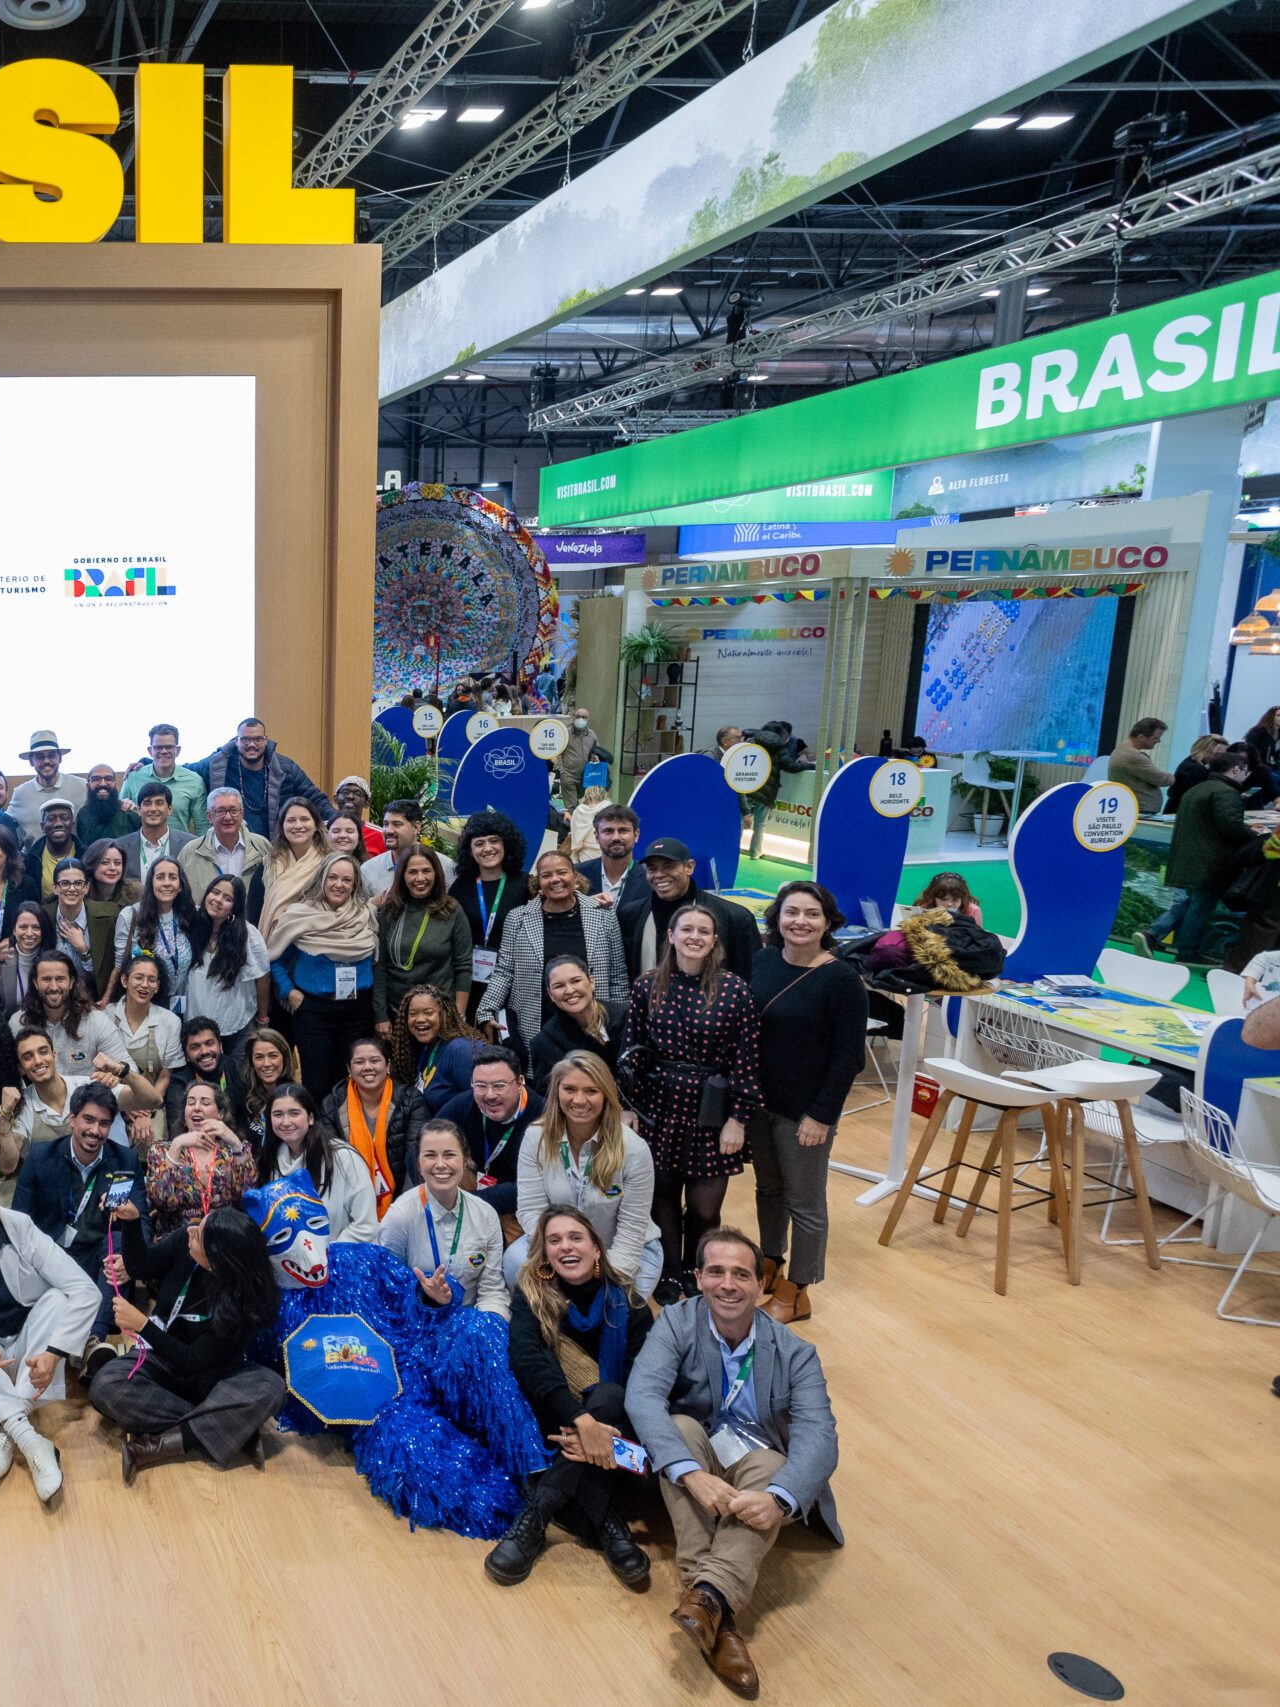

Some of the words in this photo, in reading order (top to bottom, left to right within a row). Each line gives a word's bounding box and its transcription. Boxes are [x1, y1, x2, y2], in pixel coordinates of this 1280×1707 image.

[974, 291, 1280, 431] BRASIL
[556, 474, 617, 500] VISITBRASIL.COM
[948, 479, 967, 491] ALTA
[969, 472, 1010, 488] FLORESTA
[785, 483, 874, 498] VISITBRASIL.COM
[925, 545, 1169, 572] PERNAMBUCO
[660, 553, 822, 588] PERNAMBUCO
[63, 566, 177, 598] BRASIL
[0, 586, 46, 594] TURISMO
[702, 626, 826, 641] PERNAMBUCO
[423, 712, 434, 721] 15
[478, 719, 489, 729] 16
[543, 728, 555, 739] 16
[742, 754, 757, 767] 17
[889, 771, 906, 786] 18
[1098, 797, 1119, 814] 19
[1083, 829, 1124, 838] CONVENTION
[1087, 822, 1101, 830] SÃO
[1090, 836, 1115, 844] BUREAU
